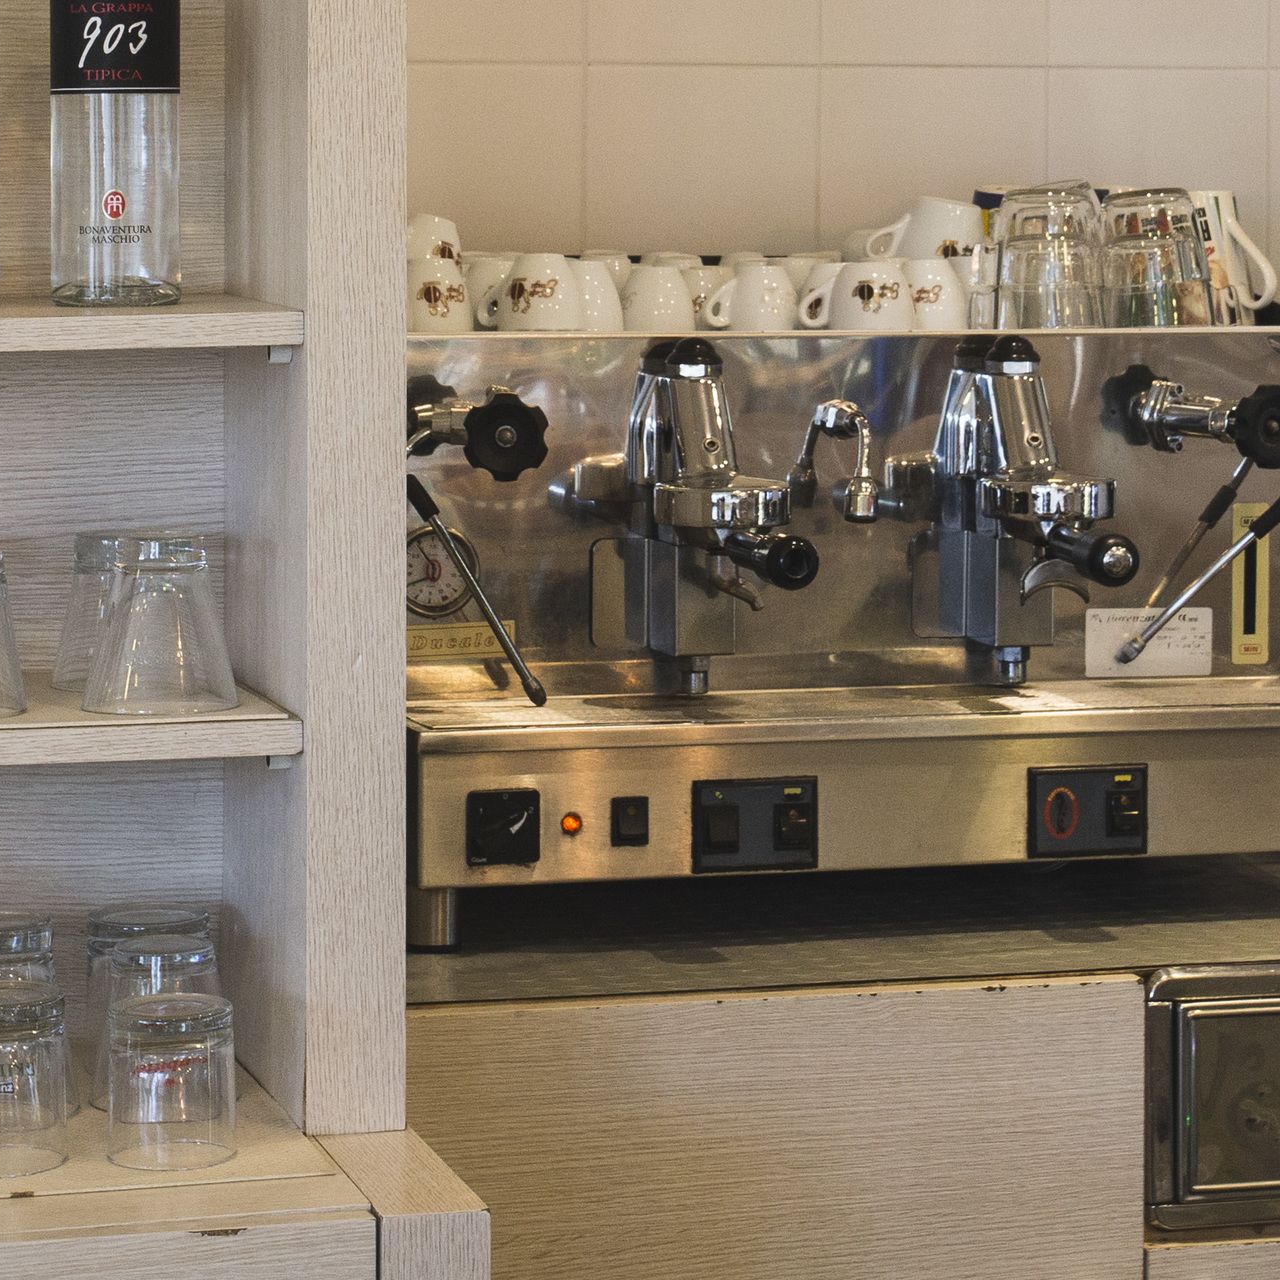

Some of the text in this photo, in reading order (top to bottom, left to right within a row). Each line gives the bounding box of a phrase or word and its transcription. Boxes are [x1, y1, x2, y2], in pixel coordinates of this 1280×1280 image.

[70, 1, 154, 13] LA GRAPPA
[78, 16, 148, 68] 903
[83, 69, 143, 81] TIPICA
[79, 225, 152, 235] BONAVENTURA
[91, 234, 140, 244] MASCHIO
[410, 632, 495, 651] Ducale
